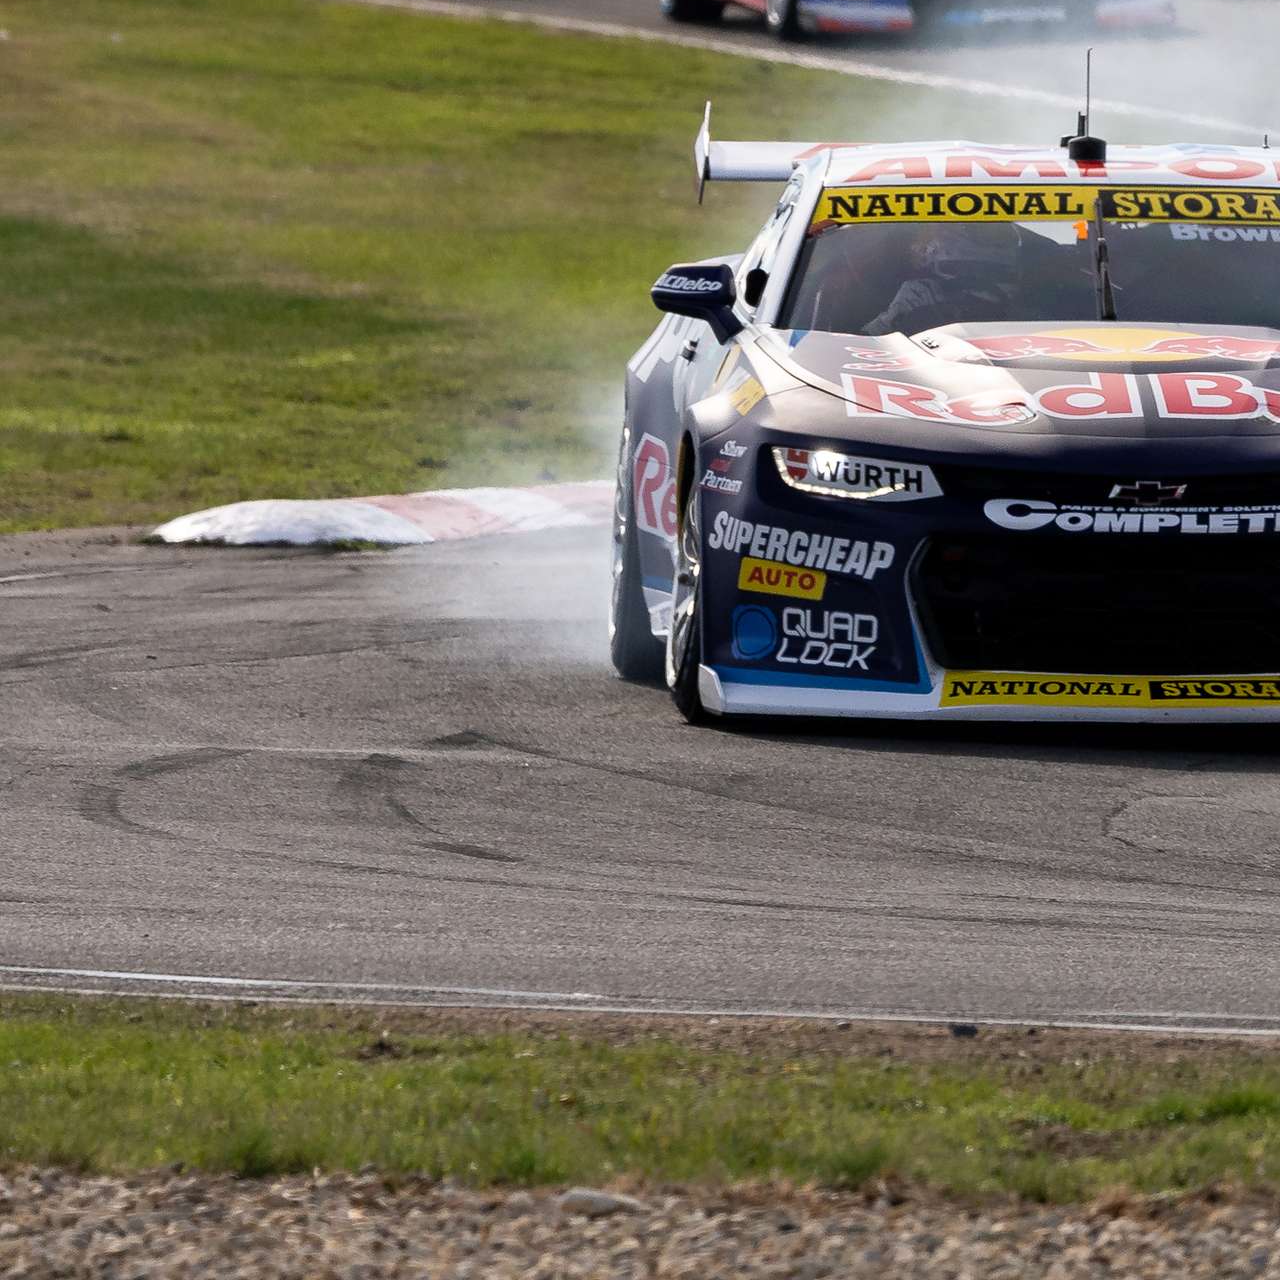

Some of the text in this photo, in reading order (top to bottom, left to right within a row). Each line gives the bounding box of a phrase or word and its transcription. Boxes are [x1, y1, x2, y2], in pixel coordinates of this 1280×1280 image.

[828, 192, 1084, 219] NATIONAL
[709, 510, 895, 580] SUPERCHEAP
[747, 566, 817, 591] AUTO
[782, 607, 878, 644] QUAD
[776, 642, 878, 670] LOCK
[948, 680, 1142, 698] NATIONAL
